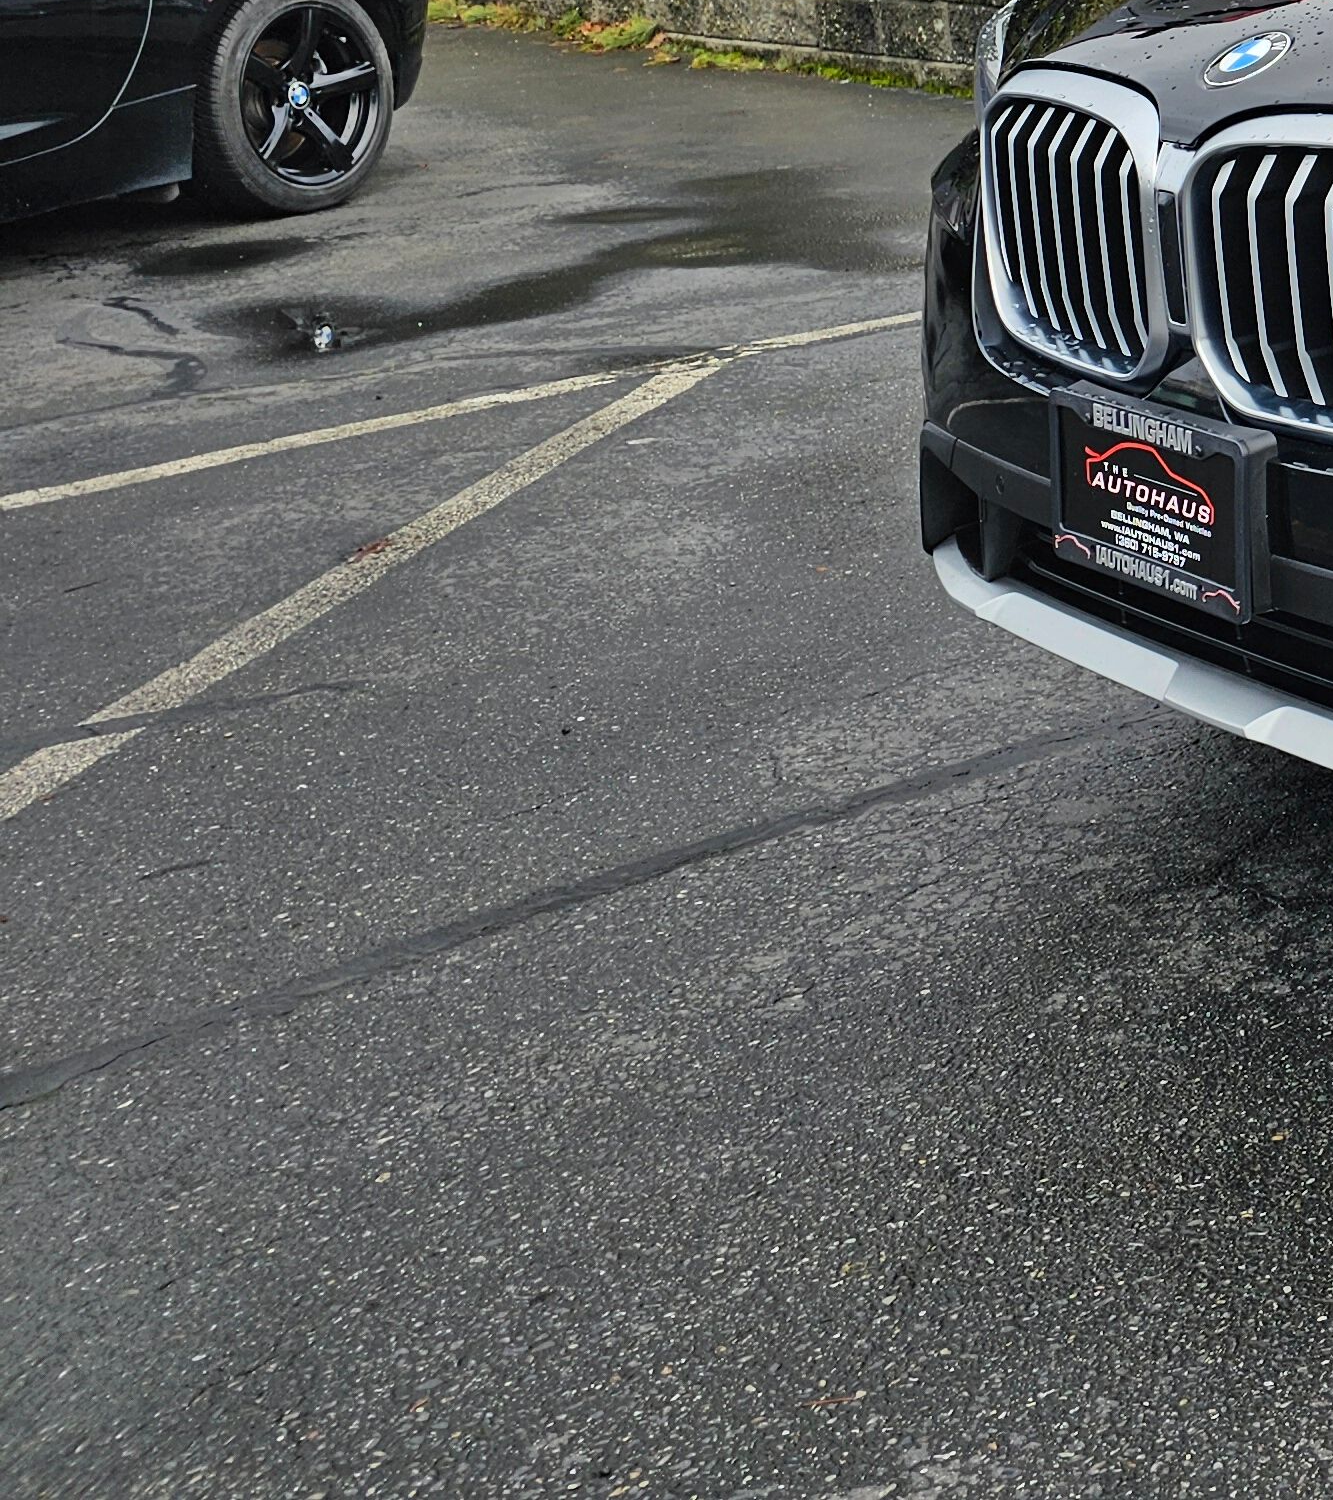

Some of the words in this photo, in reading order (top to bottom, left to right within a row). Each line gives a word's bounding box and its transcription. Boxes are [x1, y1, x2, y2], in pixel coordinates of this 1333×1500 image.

[1092, 402, 1194, 456] BELLINGHAM
[1103, 462, 1128, 478] THE
[1091, 471, 1212, 525] AUTOHAUS
[1110, 509, 1172, 540] BELLINGHAM,
[1173, 531, 1191, 546] WA
